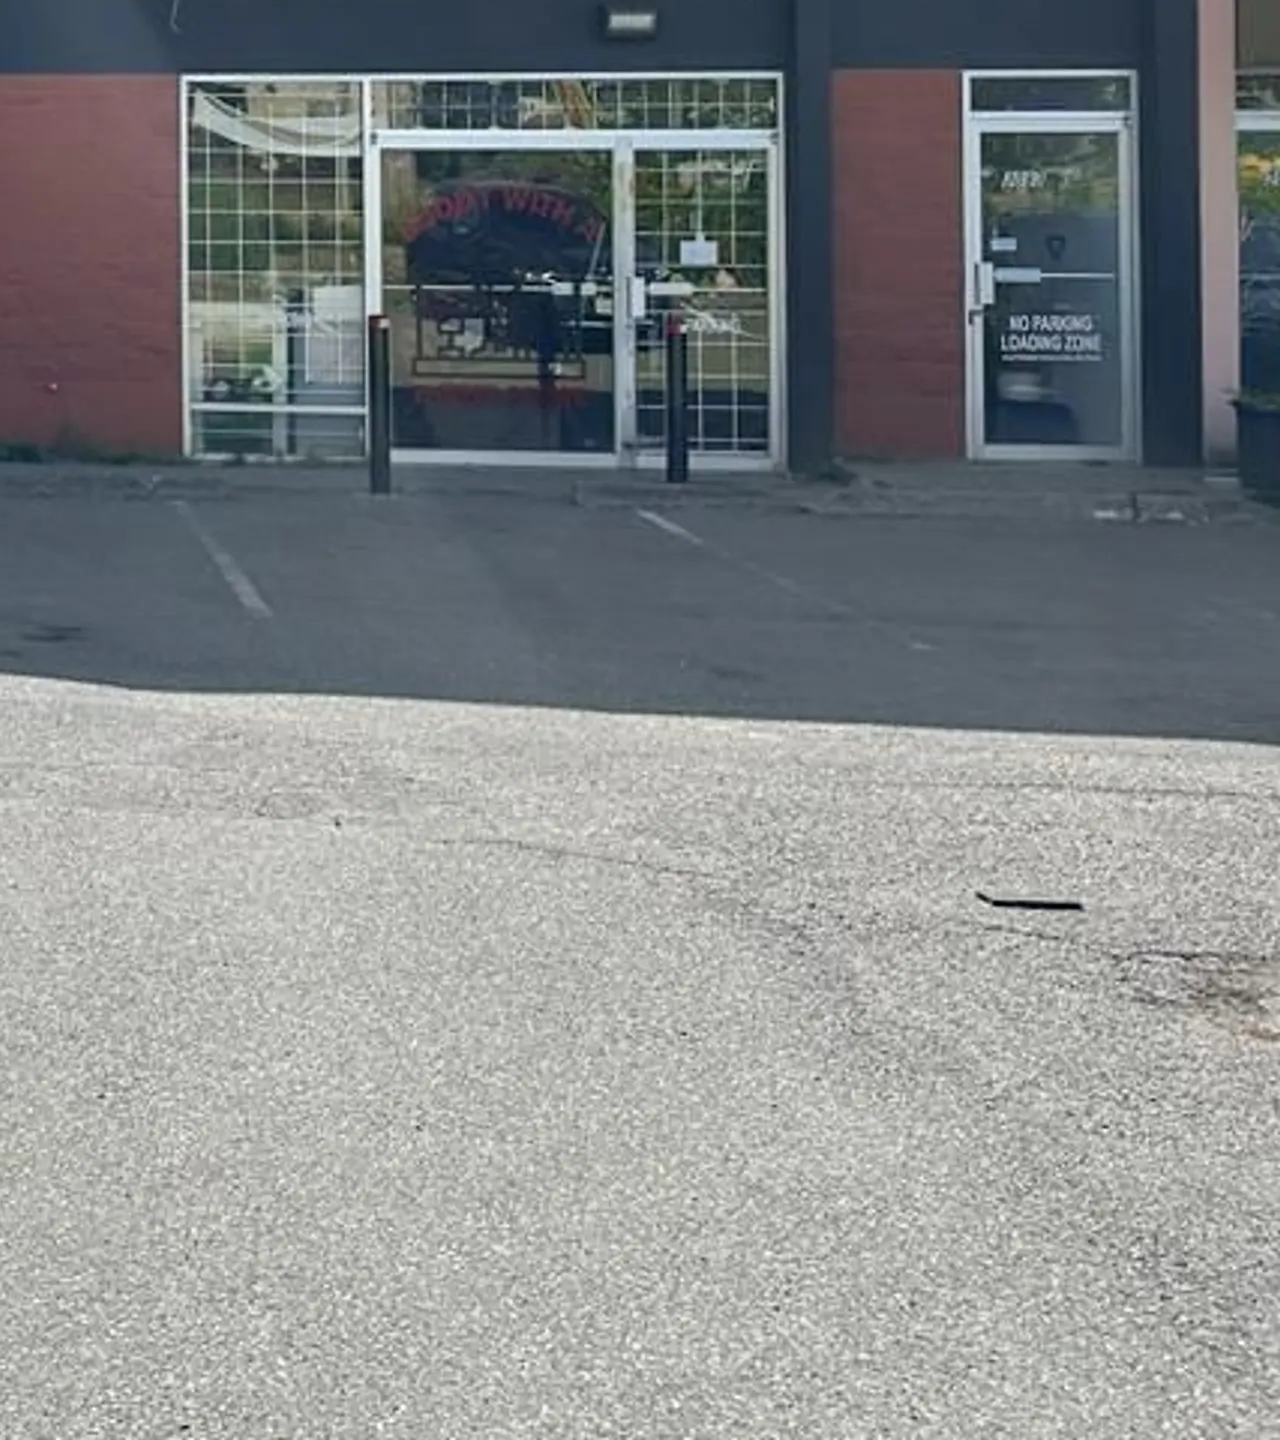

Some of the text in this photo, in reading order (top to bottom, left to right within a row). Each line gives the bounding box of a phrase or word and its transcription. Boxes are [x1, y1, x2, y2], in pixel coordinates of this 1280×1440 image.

[1009, 315, 1093, 332] NO PARKING
[1000, 333, 1102, 352] LOADING ZONE
